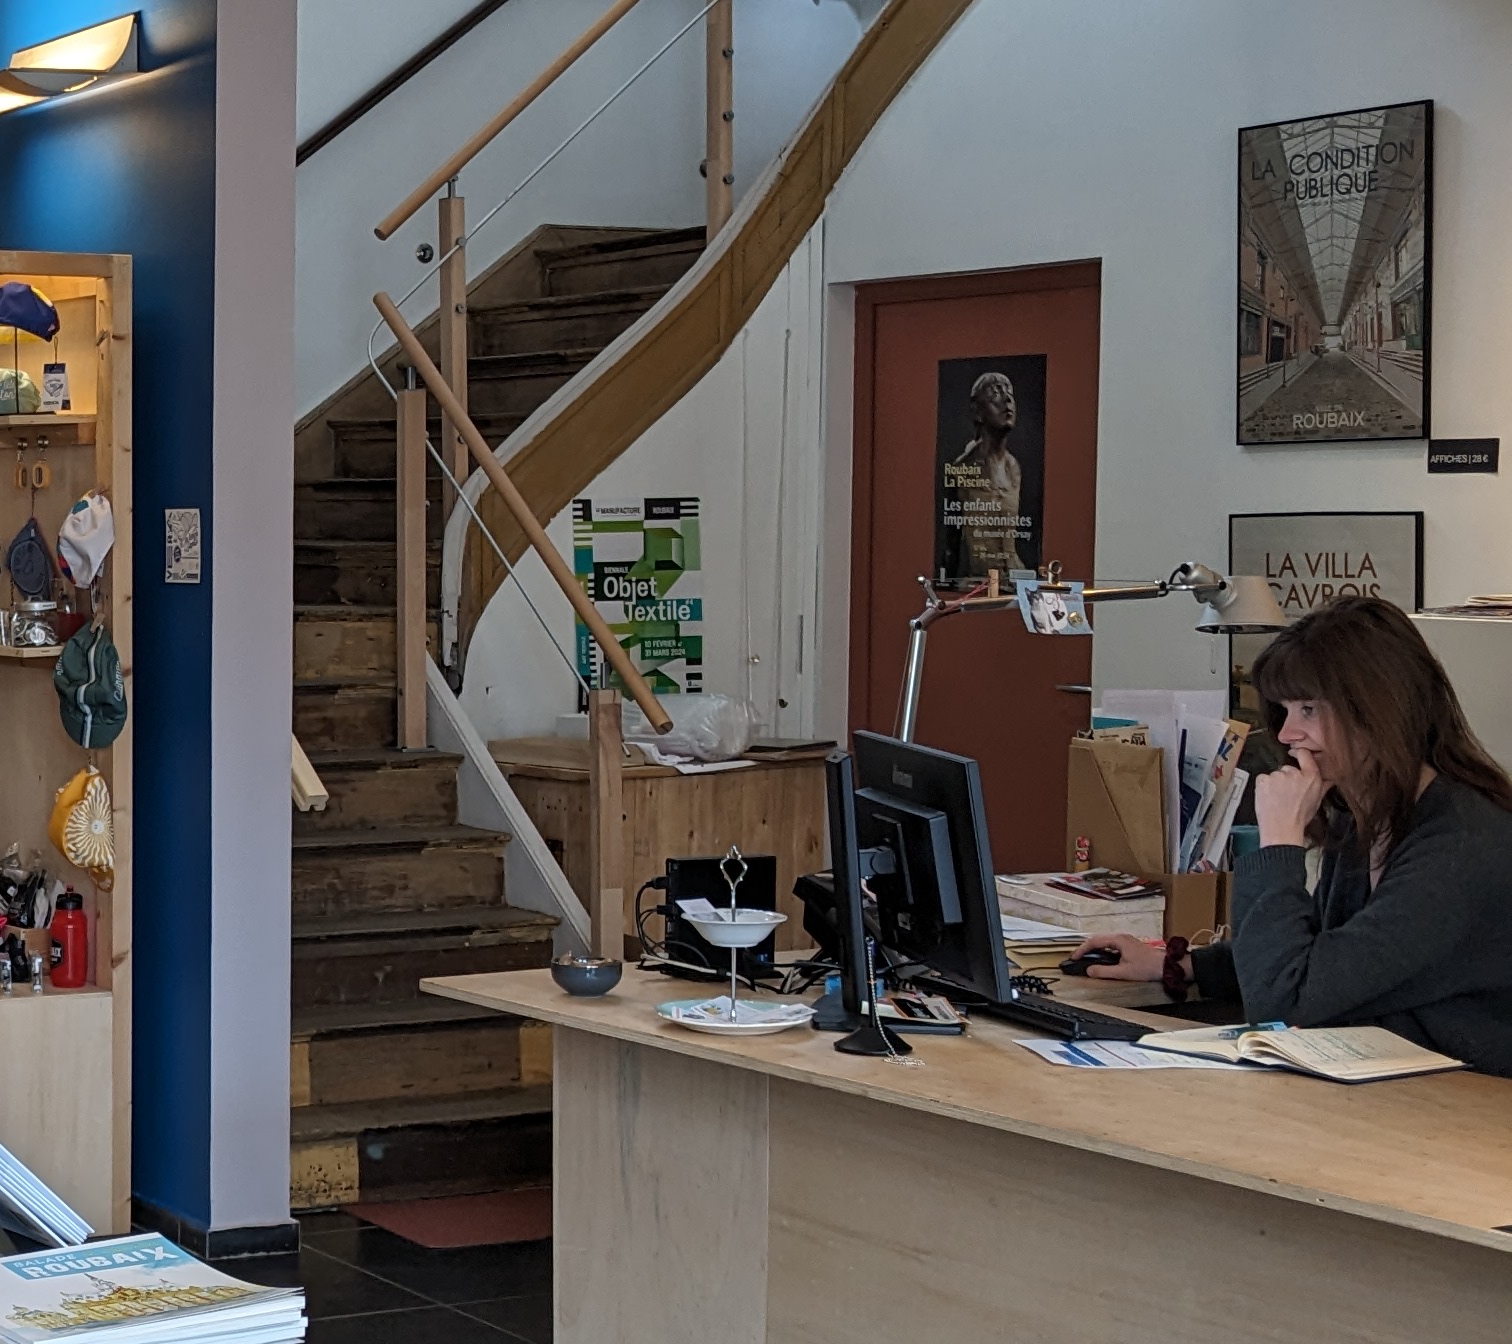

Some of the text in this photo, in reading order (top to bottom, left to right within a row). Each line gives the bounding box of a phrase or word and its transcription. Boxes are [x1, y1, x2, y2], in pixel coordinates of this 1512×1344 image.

[1251, 139, 1414, 181] LA CONDITION
[1284, 170, 1378, 201] PUBLIQUE
[1292, 412, 1365, 429] ROUBAIX
[944, 462, 982, 476] Roubaix
[1430, 455, 1468, 464] AFFICHES
[944, 475, 990, 488] La Piscine
[944, 498, 1002, 512] Les enfants
[943, 512, 1033, 530] impressionnistes
[1266, 552, 1378, 578] LA VILLA
[603, 575, 658, 605] Objet
[625, 600, 691, 623] Textile
[21, 1245, 179, 1279] ROUBAIX
